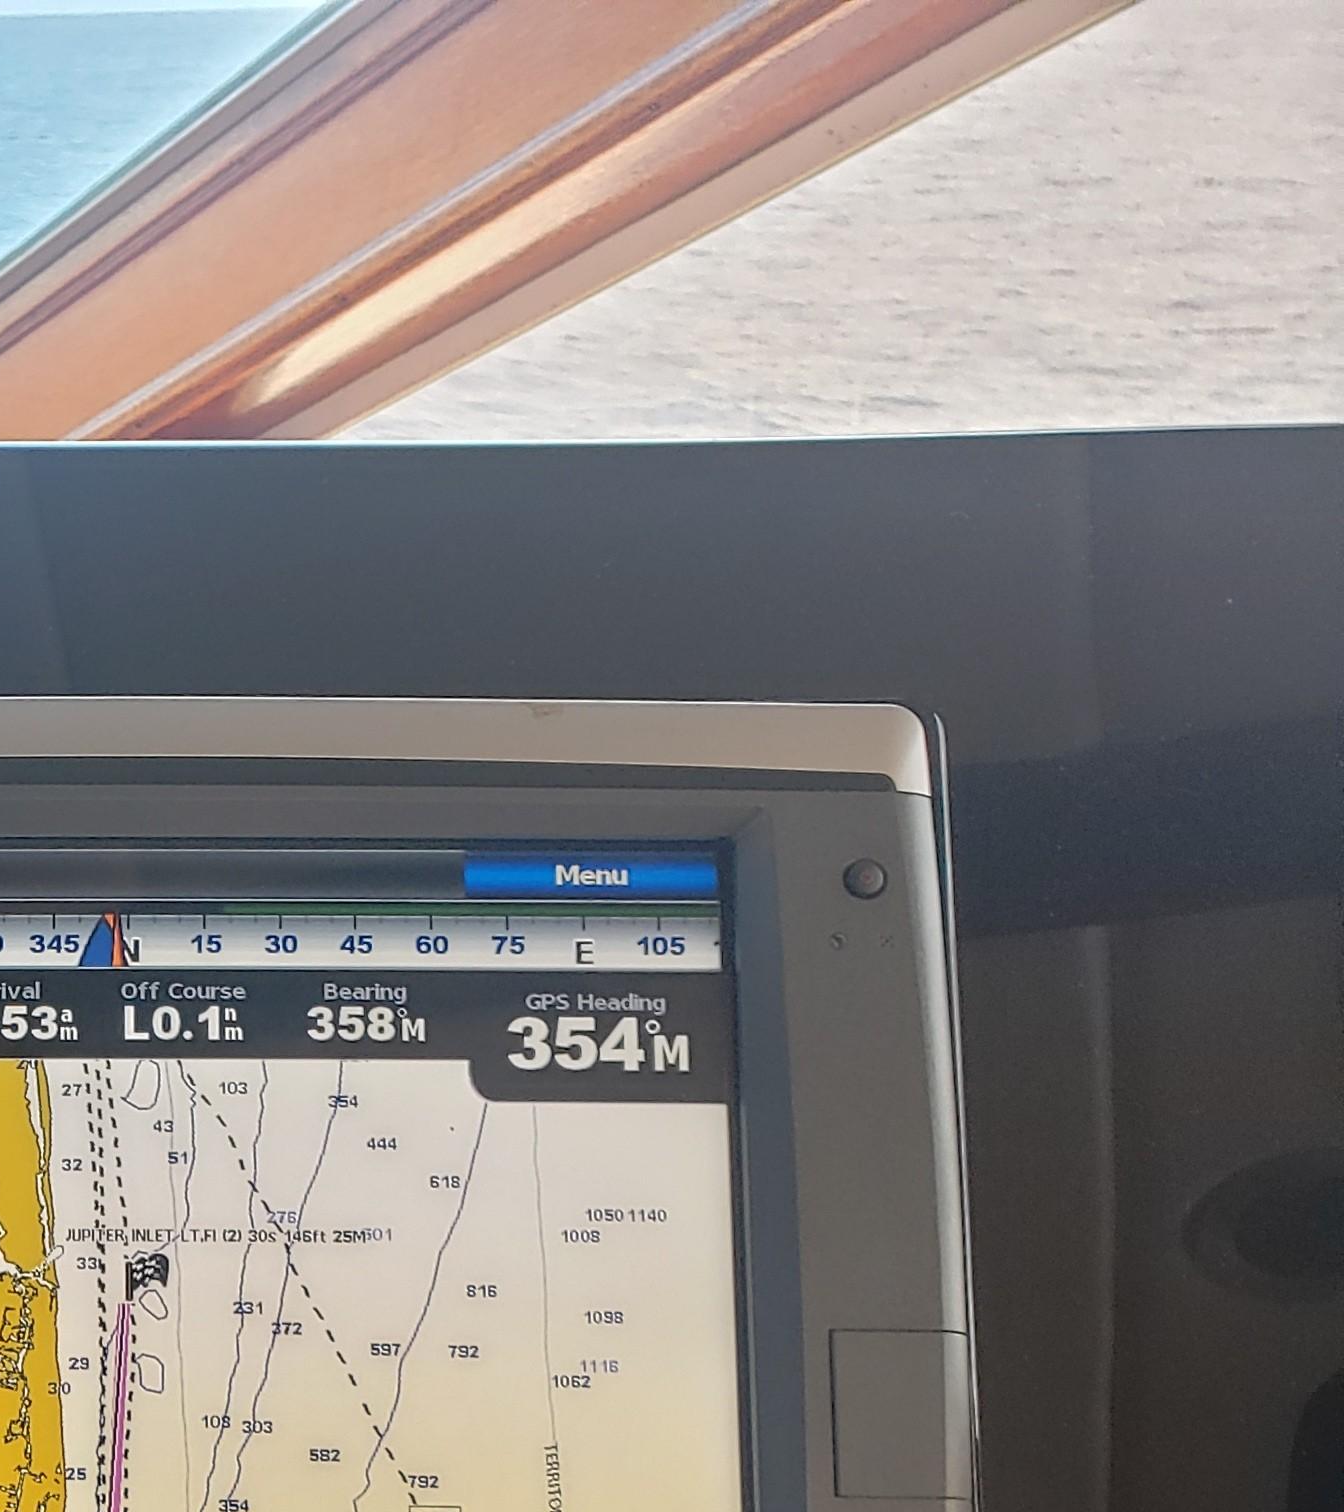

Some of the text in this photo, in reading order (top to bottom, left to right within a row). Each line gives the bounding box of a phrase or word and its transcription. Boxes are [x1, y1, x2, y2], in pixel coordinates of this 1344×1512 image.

[555, 864, 629, 887] Menu
[29, 934, 80, 954] 345
[191, 935, 222, 954] 15
[264, 935, 298, 954] 30
[340, 935, 373, 954] 45
[415, 936, 449, 955] 60
[492, 936, 525, 955] 75
[575, 940, 595, 965] E
[636, 937, 686, 956] 105
[120, 981, 246, 1001] Off Course
[323, 983, 407, 1004] Bearing
[525, 993, 666, 1015] GPS Heading
[124, 1005, 221, 1042] L0.1
[61, 1084, 82, 1097] 27
[218, 1082, 248, 1095] 103
[327, 1096, 359, 1109] 354
[153, 1120, 174, 1133] 43
[367, 1137, 397, 1151] 444
[167, 1152, 188, 1165] 51
[61, 1159, 82, 1172] 32
[429, 1176, 461, 1189] 618
[267, 1211, 297, 1224] 276
[585, 1209, 667, 1222] 1050 1140
[131, 1229, 172, 1242] INLET
[223, 1229, 242, 1243] (2)
[248, 1229, 276, 1243] 30s
[284, 1229, 326, 1244] 146ft
[332, 1230, 367, 1244] 25M
[561, 1230, 601, 1243] 1008
[76, 1257, 97, 1270] 33
[466, 1285, 497, 1298] 816
[232, 1301, 263, 1315] 231
[271, 1322, 302, 1335] 372
[370, 1344, 401, 1356] 597
[448, 1345, 479, 1358] 792
[68, 1358, 90, 1370] 29
[552, 1376, 591, 1388] 1062
[242, 1421, 273, 1434] 303
[309, 1449, 341, 1462] 582
[65, 1468, 87, 1481] 25
[408, 1475, 439, 1488] 792
[218, 1500, 249, 1512] 354
